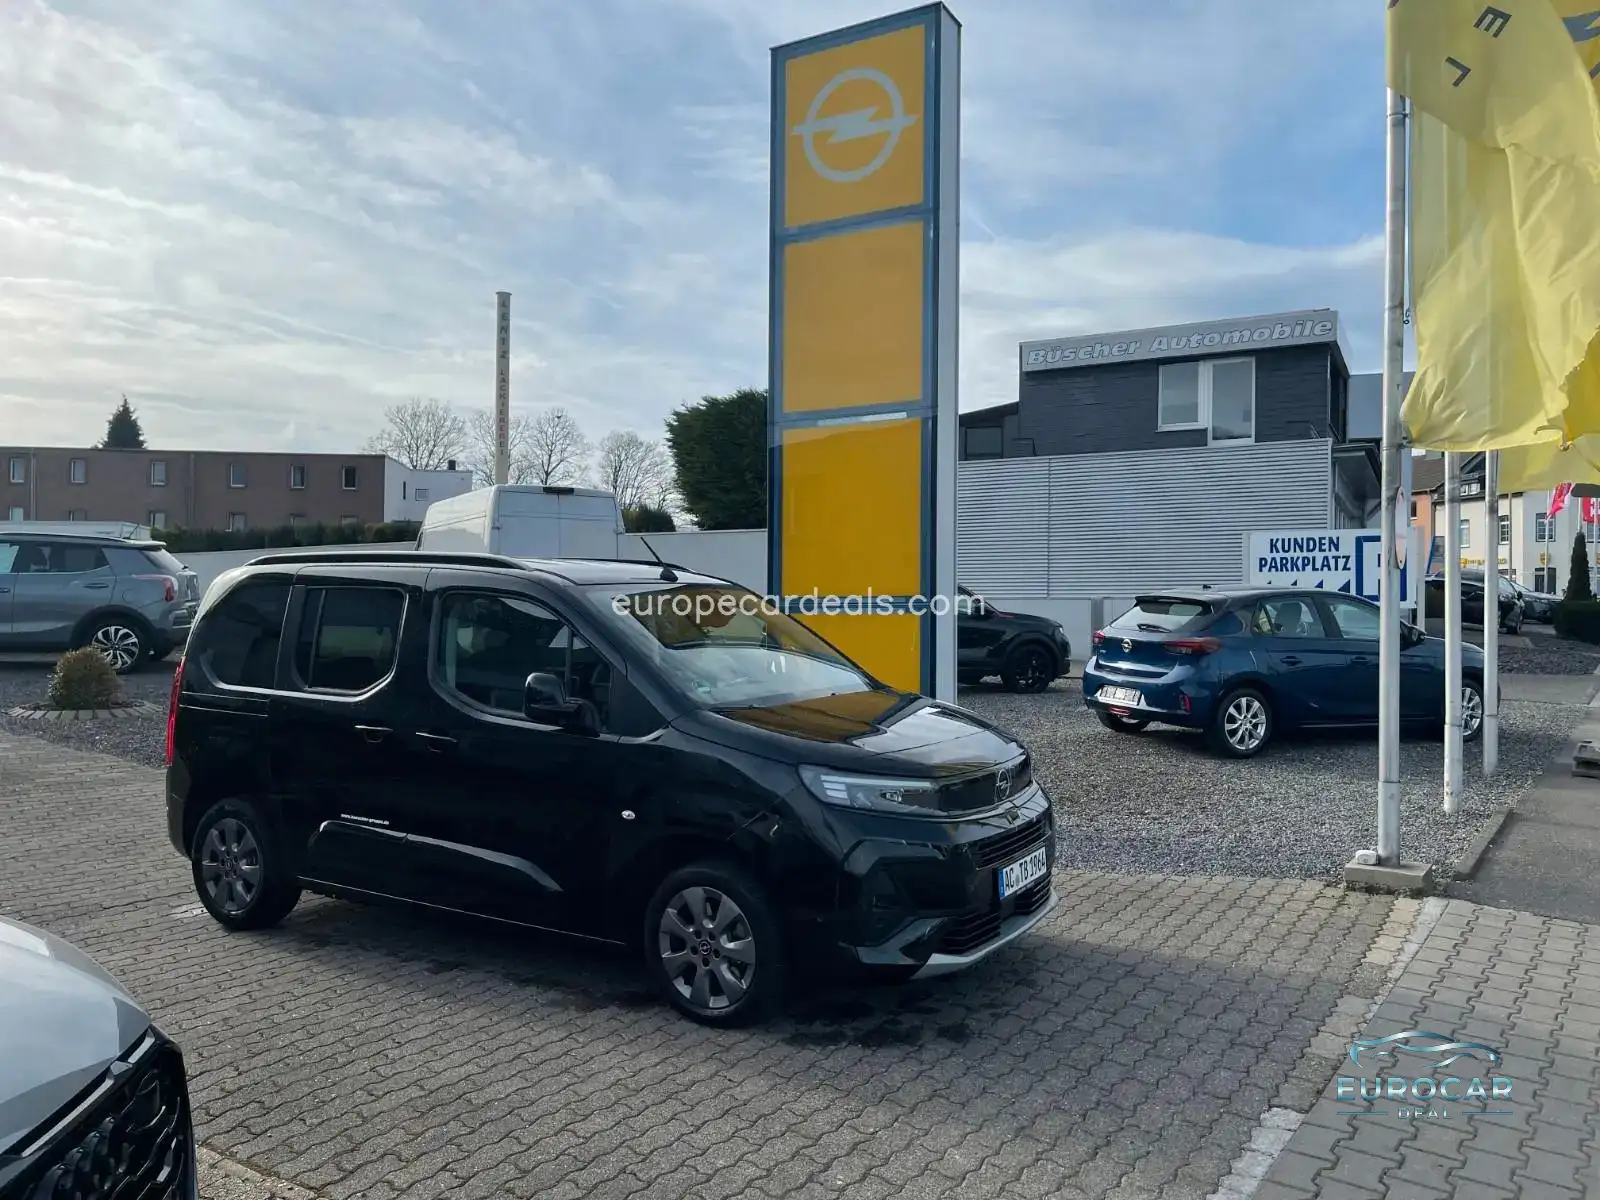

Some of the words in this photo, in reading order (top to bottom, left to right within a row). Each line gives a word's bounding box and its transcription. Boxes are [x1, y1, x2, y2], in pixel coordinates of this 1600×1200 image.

[1026, 339, 1142, 366] Büscher
[1149, 319, 1334, 353] Automobile
[1269, 536, 1340, 554] KUNDEN
[1258, 554, 1351, 573] PARKPLATZ
